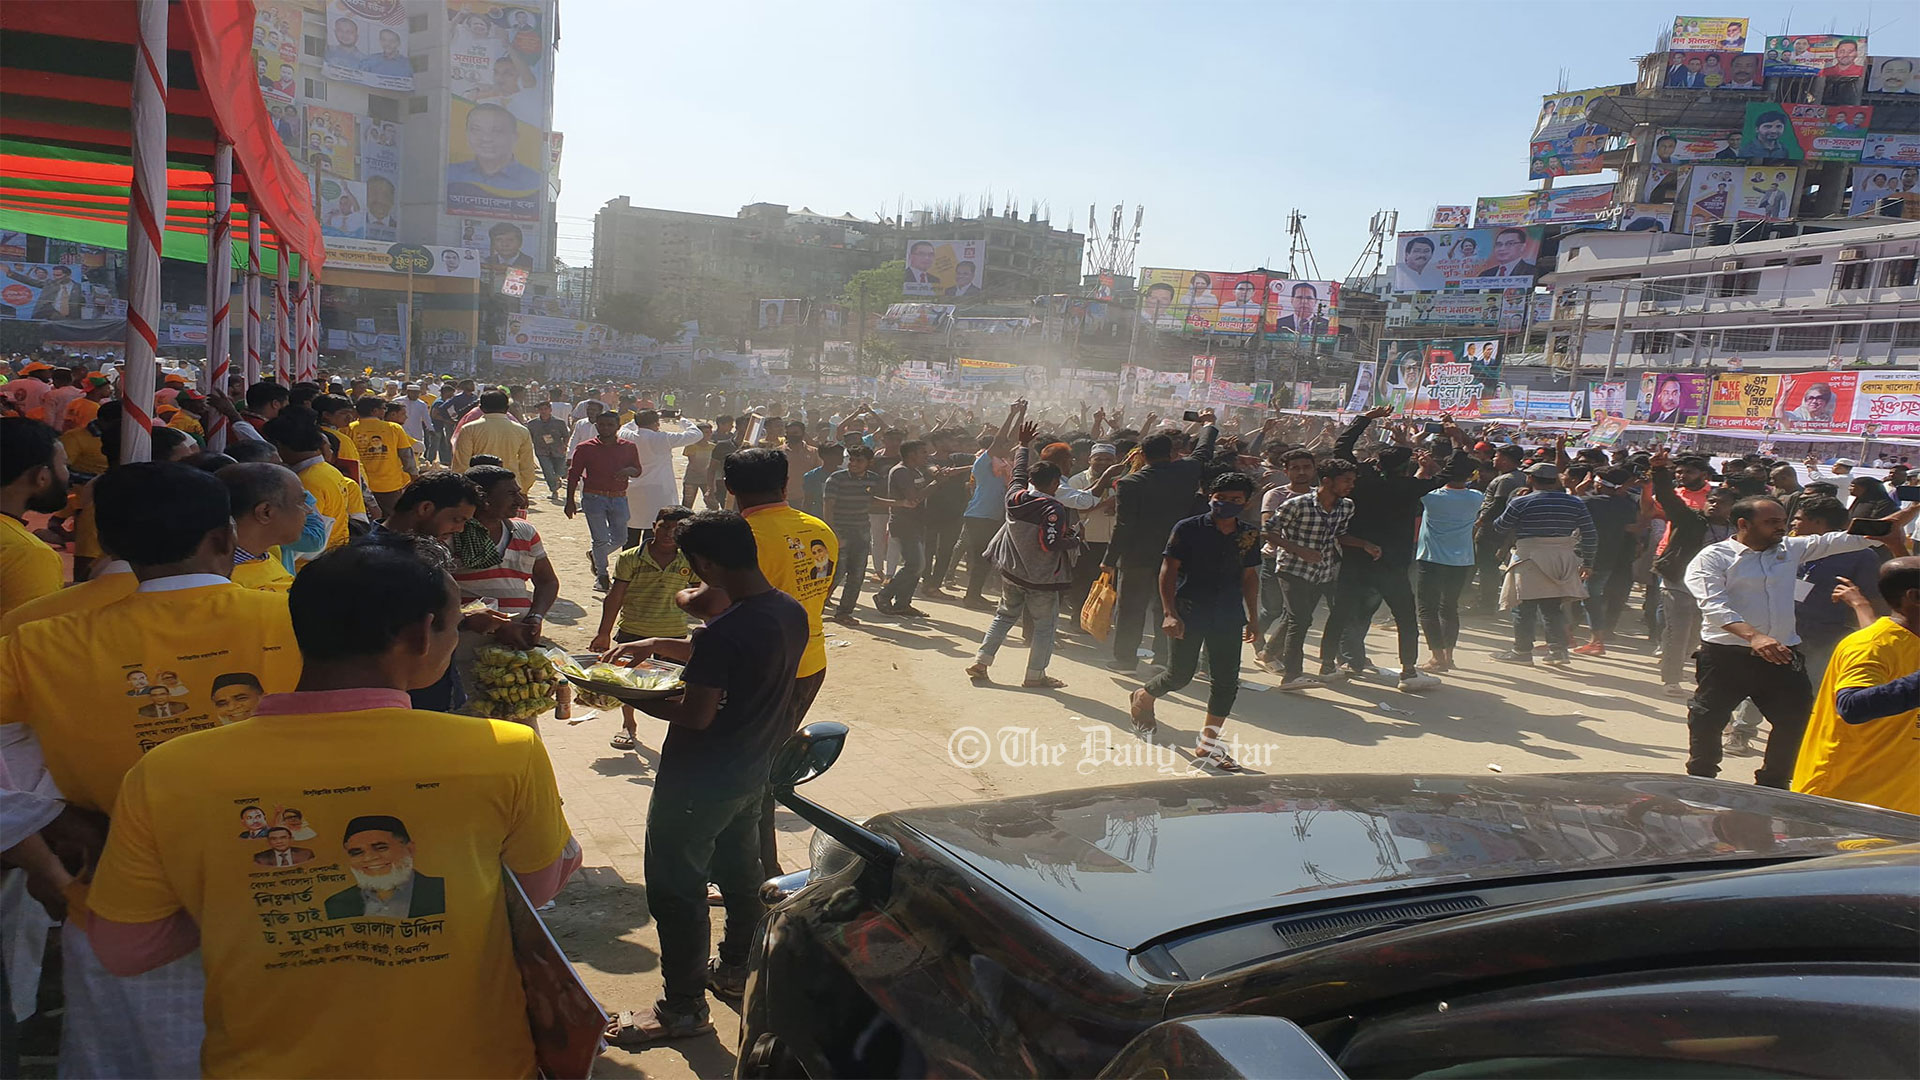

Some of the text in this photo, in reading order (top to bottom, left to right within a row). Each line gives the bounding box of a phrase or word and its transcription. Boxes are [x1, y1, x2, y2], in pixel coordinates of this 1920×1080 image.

[1594, 205, 1622, 220] vivo
[1430, 362, 1472, 381] দুঃশাসন
[1861, 383, 1883, 391] বেগম
[1885, 383, 1914, 391] খালেদা
[1749, 394, 1774, 406] বিচার
[1869, 395, 1901, 420] মুক্তি
[1728, 418, 1744, 426] জেলা
[250, 874, 346, 890] বেগম খালেদা জিয়ার
[254, 886, 314, 907] নিঃশর্ত
[259, 908, 324, 928] মুক্তি চাই
[263, 918, 445, 946] ড. মুহাম্মদ জালাল উদ্দিন
